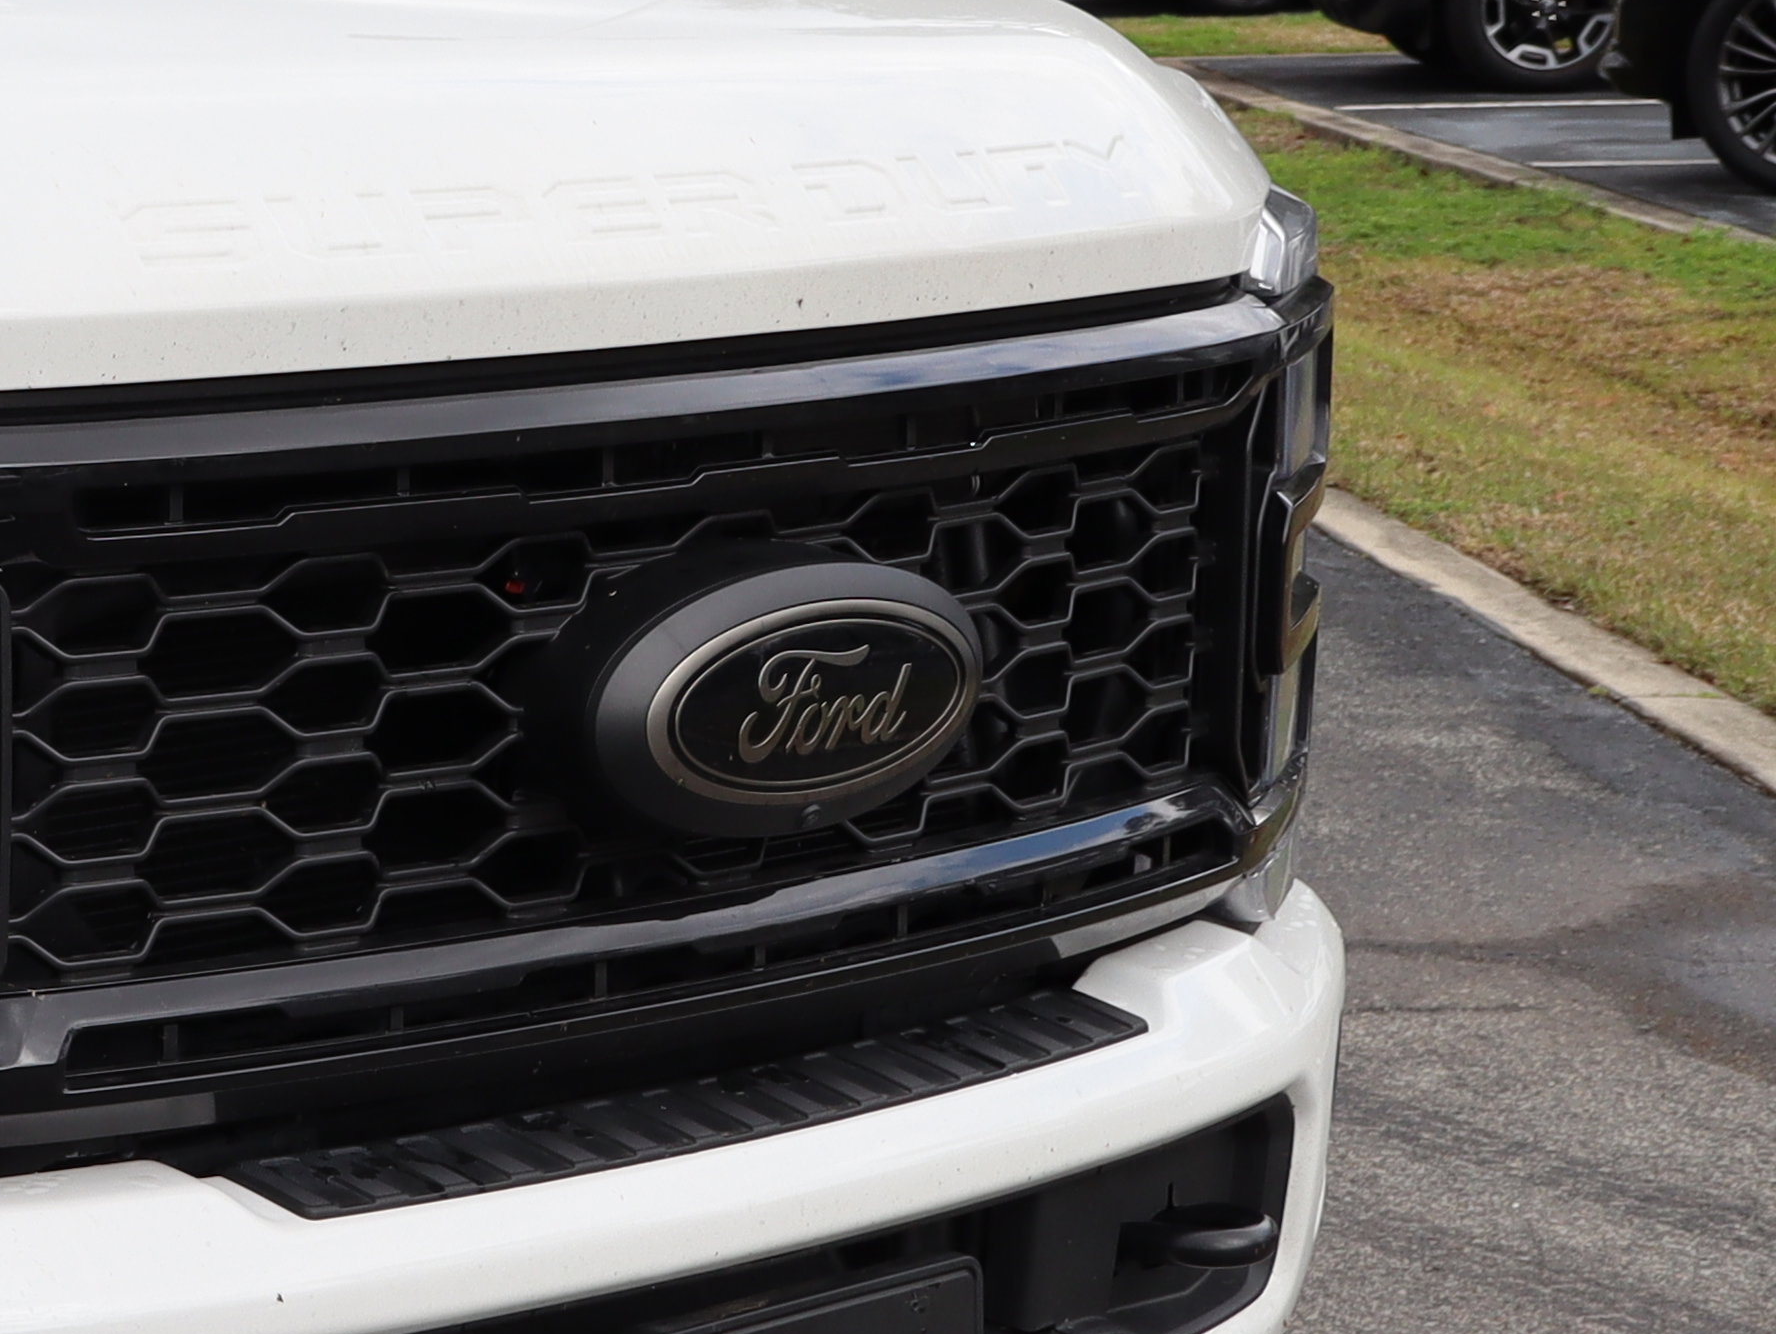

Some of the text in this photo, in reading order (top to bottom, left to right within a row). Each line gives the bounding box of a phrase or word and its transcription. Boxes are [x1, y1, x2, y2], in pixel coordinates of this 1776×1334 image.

[118, 133, 1138, 268] SUPER DUTY
[737, 643, 913, 764] Ford
